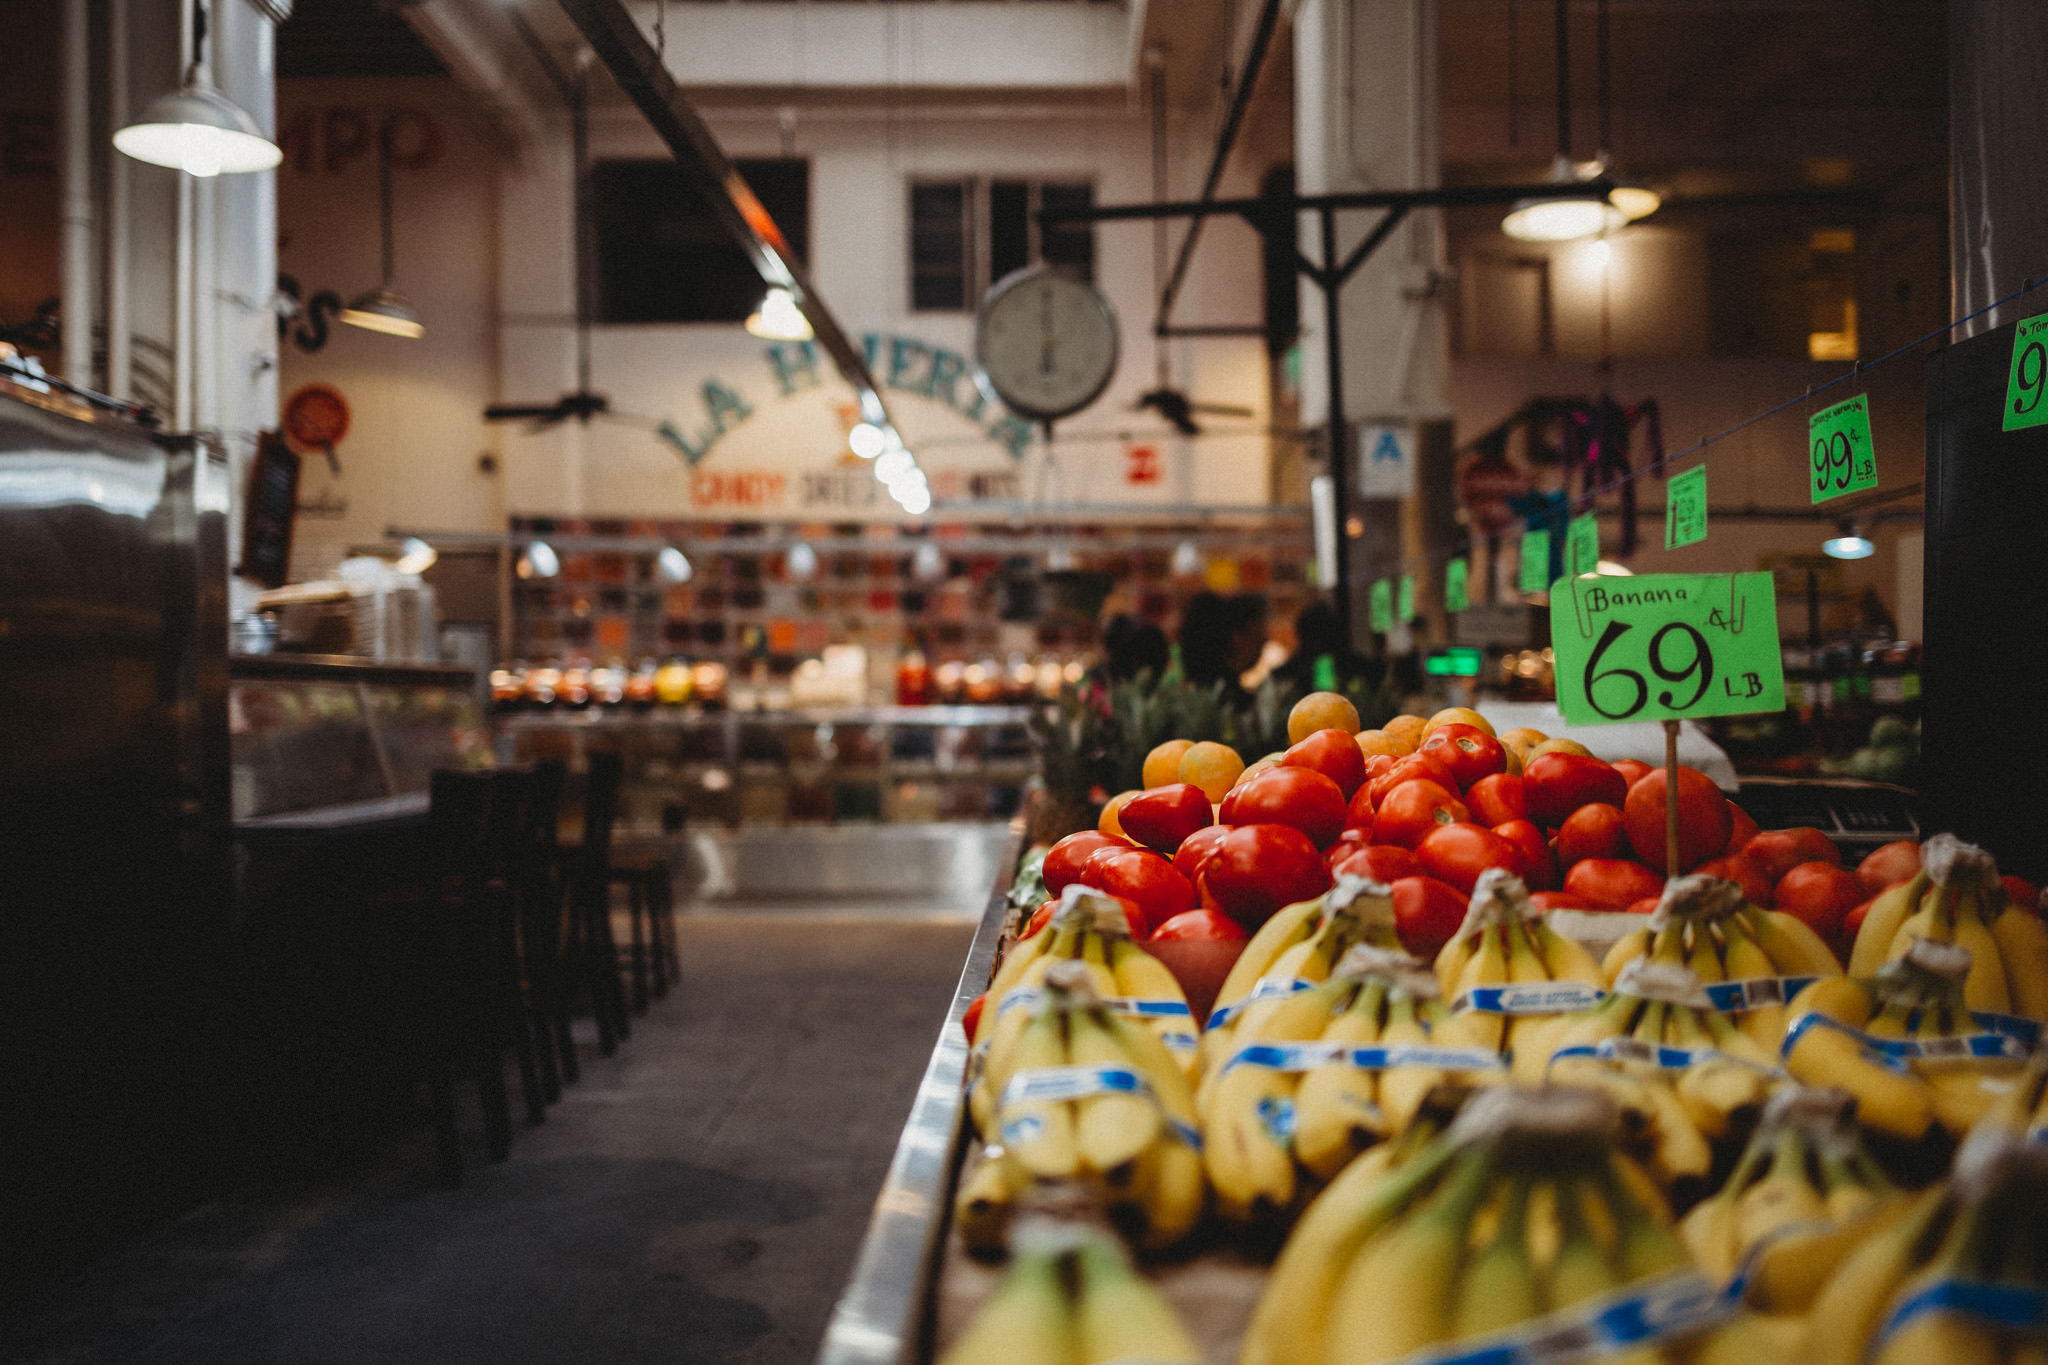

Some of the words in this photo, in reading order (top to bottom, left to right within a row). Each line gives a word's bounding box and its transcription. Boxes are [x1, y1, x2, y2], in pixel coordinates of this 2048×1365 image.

[657, 378, 752, 466] LA
[1374, 429, 1402, 461] A
[1814, 431, 1854, 491] 99
[1855, 459, 1873, 477] LB
[1590, 586, 1688, 613] Banana
[1583, 619, 1714, 720] 69
[1723, 671, 1764, 699] LB
